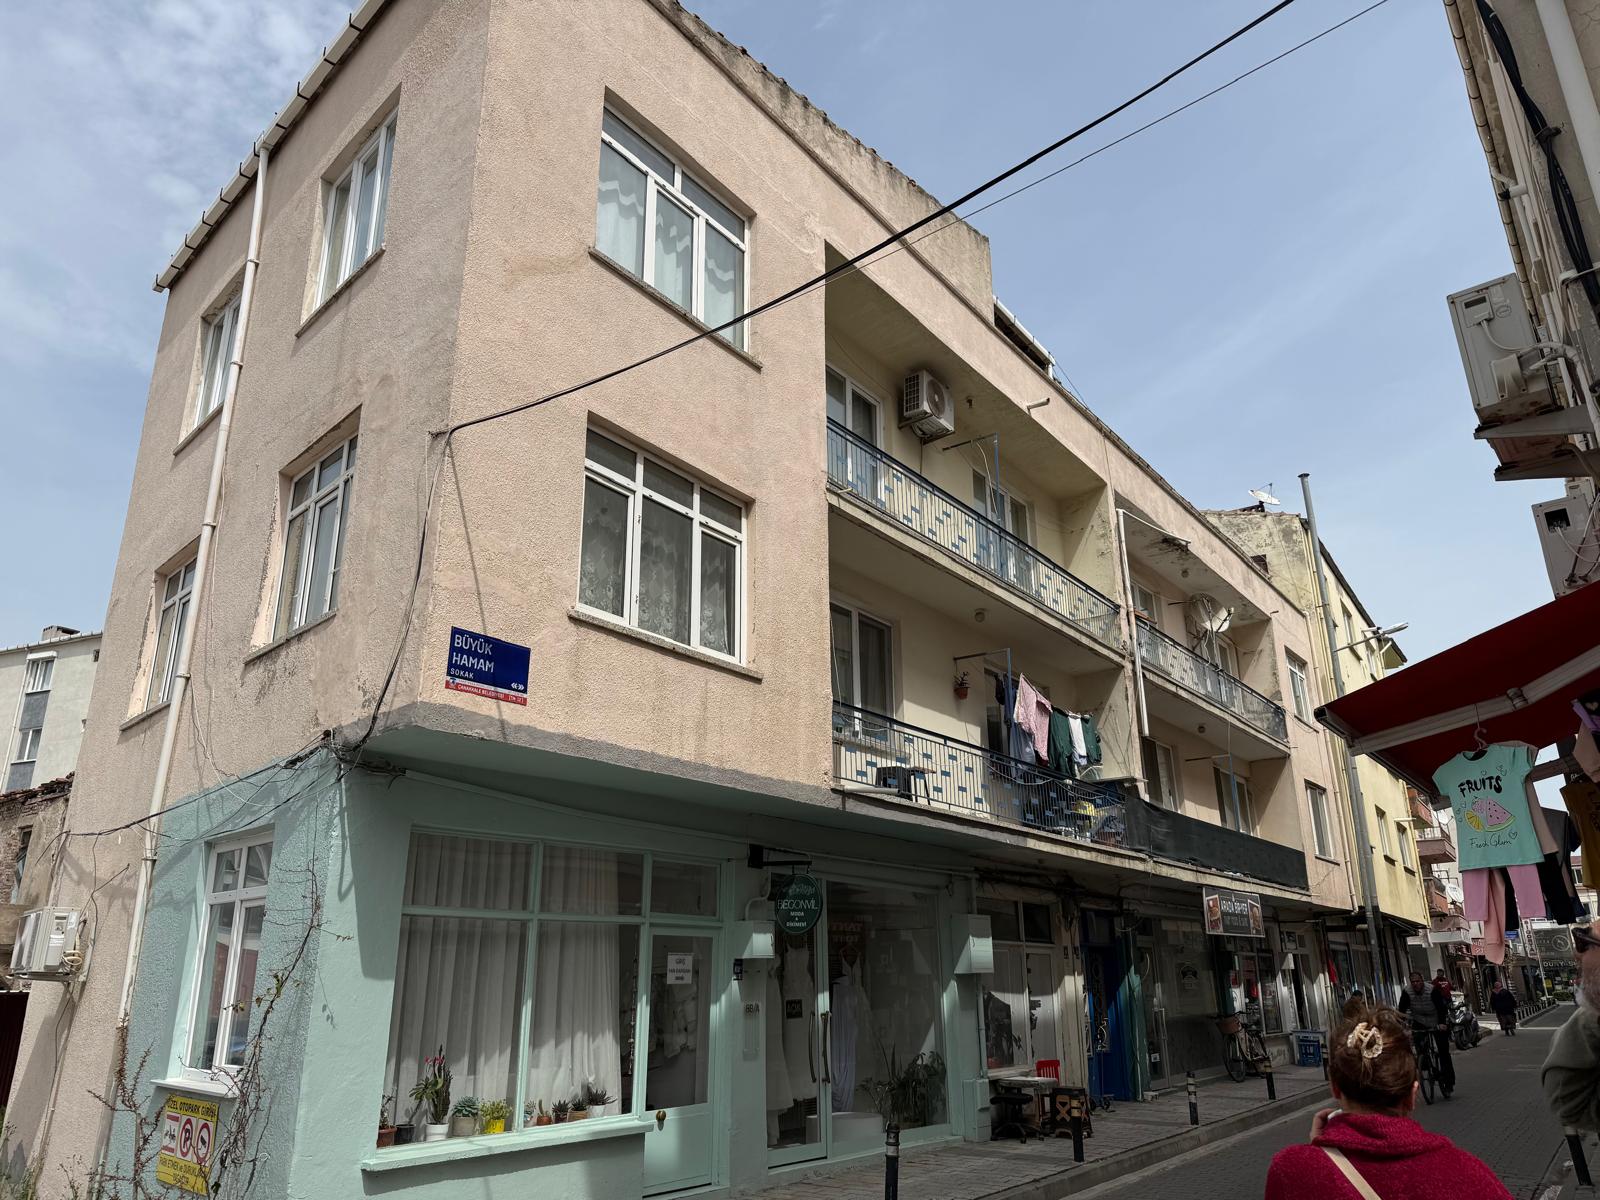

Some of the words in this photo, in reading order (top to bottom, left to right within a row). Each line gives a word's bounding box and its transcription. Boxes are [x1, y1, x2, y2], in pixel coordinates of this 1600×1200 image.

[454, 634, 493, 655] BÜYÜK
[452, 651, 494, 672] HAMAM
[450, 667, 474, 679] SOKAK
[1457, 775, 1503, 798] FRUITS
[179, 1101, 201, 1112] OTOPARK
